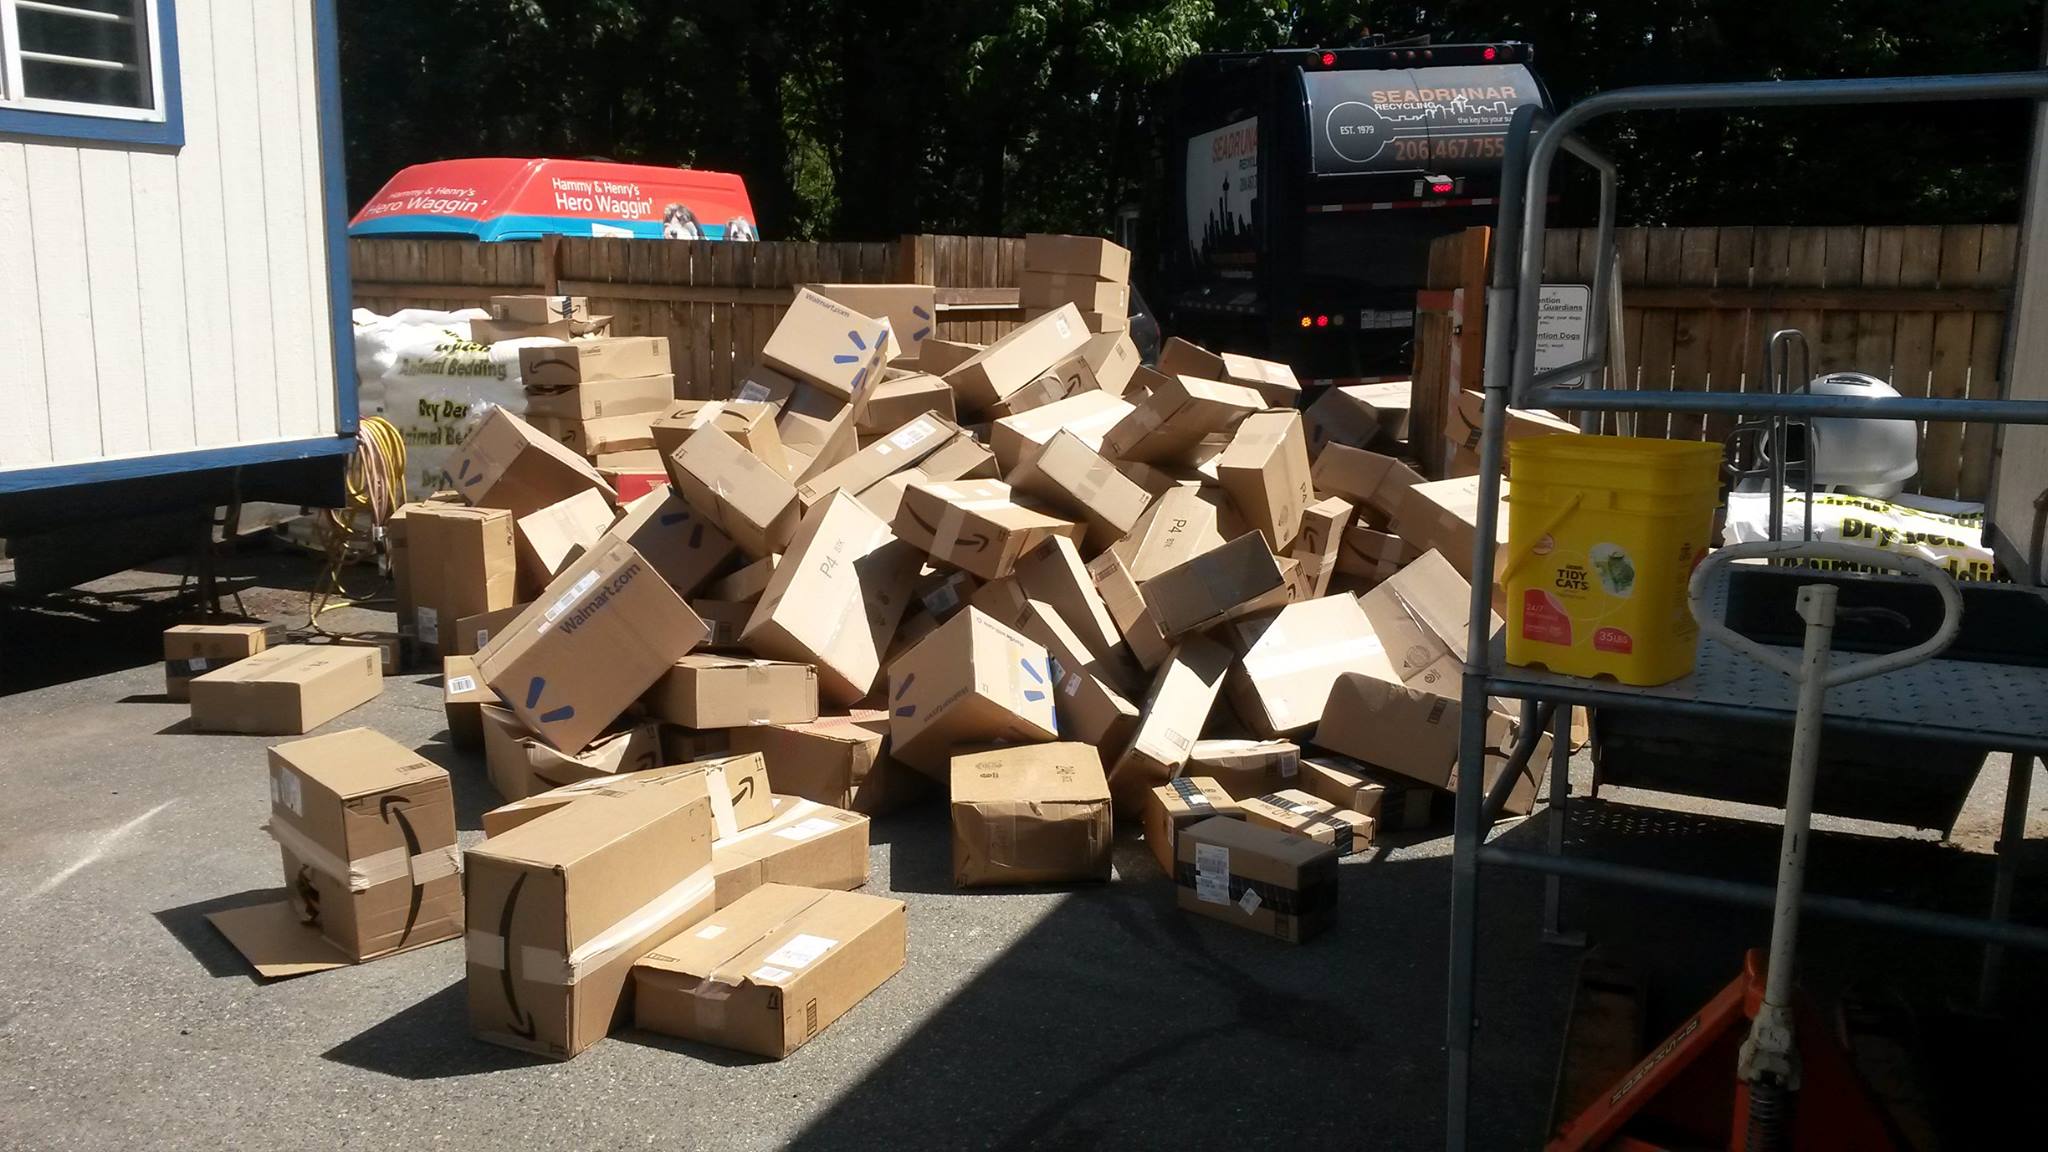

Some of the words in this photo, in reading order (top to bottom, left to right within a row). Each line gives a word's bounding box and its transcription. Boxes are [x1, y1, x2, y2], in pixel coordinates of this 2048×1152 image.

[1371, 86, 1517, 104] SEADRUNAR
[1374, 101, 1435, 111] RECYCLING
[1340, 126, 1356, 135] EST.
[1357, 125, 1375, 134] 1979
[1395, 137, 1505, 162] 206.467.755
[434, 186, 475, 197] Henry's
[552, 177, 592, 195] Hammy
[594, 181, 602, 193] &
[603, 181, 640, 198] Henry's
[406, 197, 488, 214] Waggin'
[555, 192, 593, 212] Hero
[595, 195, 653, 219] Waggin'
[1543, 303, 1583, 312] Guardians
[1559, 332, 1580, 341] Dogs
[447, 359, 507, 381] Bedding
[418, 399, 440, 422] Dry
[1843, 517, 1890, 547] Dry
[1557, 569, 1588, 581] TIDY
[1555, 578, 1589, 591] CATS
[559, 562, 642, 635] Walmart.com
